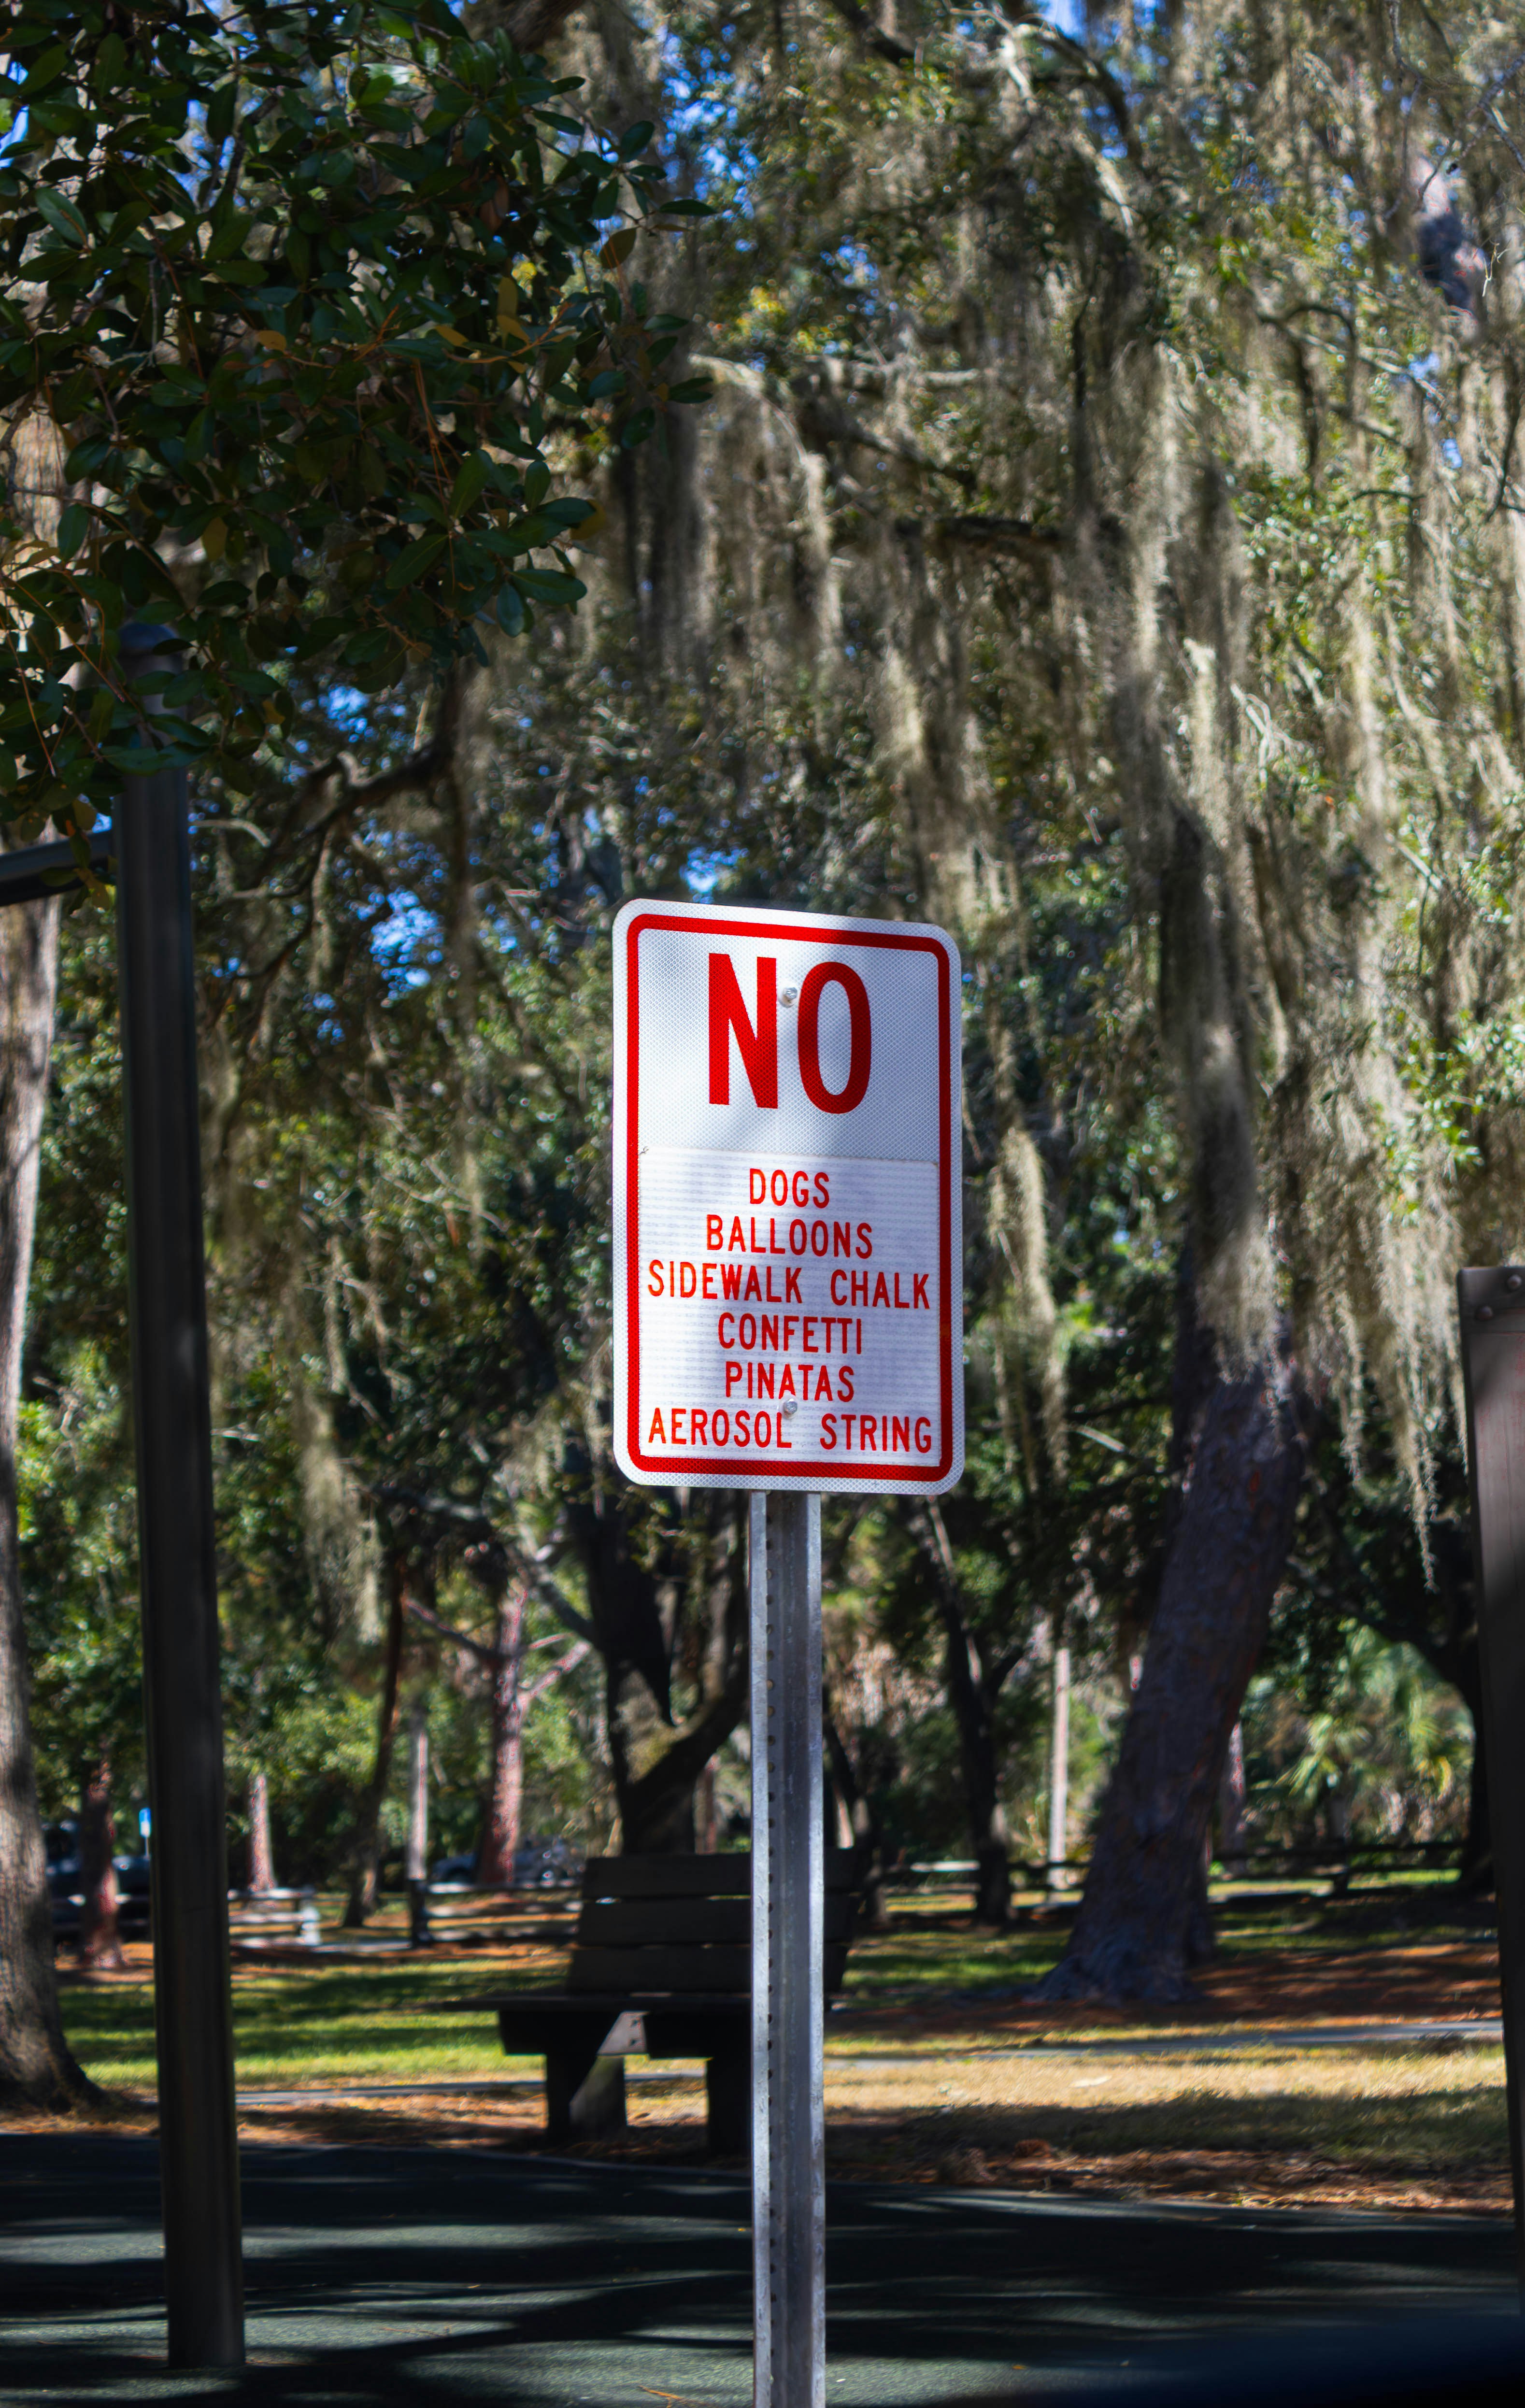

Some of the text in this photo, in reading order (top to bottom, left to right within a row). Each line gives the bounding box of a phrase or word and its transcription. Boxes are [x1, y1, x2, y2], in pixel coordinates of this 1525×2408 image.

[708, 953, 871, 1114] NO
[749, 1168, 830, 1209] DOGS
[706, 1214, 872, 1259] BALLOONS
[647, 1259, 930, 1310] SIDEWALK CHALK
[717, 1311, 862, 1355] CONFETTI
[725, 1361, 854, 1403] PINATAS
[648, 1407, 932, 1453] AEROSOL STRING
